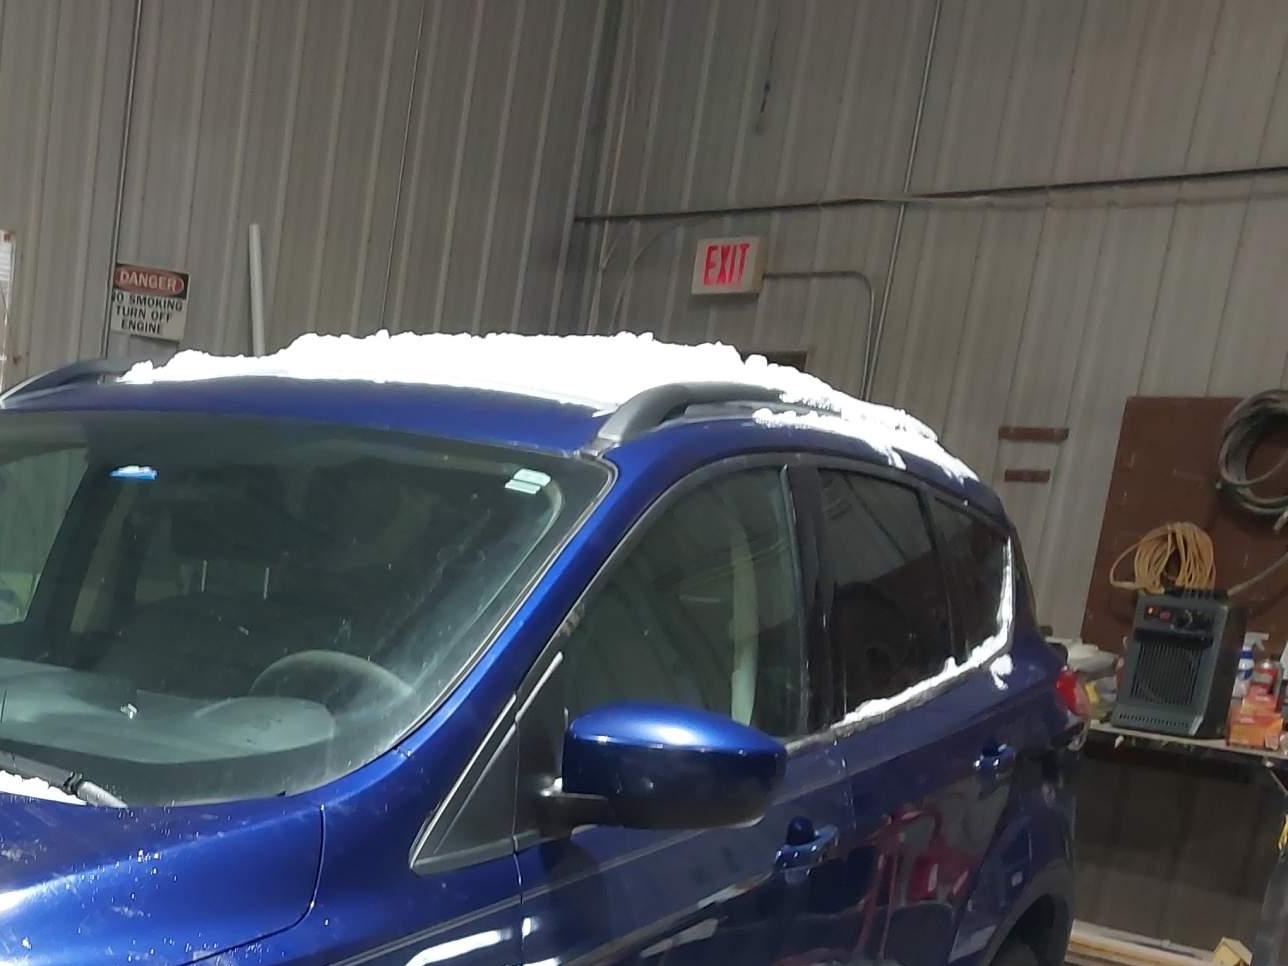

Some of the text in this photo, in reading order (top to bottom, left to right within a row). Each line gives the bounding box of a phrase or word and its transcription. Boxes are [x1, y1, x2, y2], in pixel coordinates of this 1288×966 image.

[703, 242, 750, 287] EXIT
[120, 271, 177, 292] DANGER
[129, 295, 183, 311] SMOKING
[116, 305, 171, 323] TURN OFF
[121, 319, 162, 334] ENGINE
